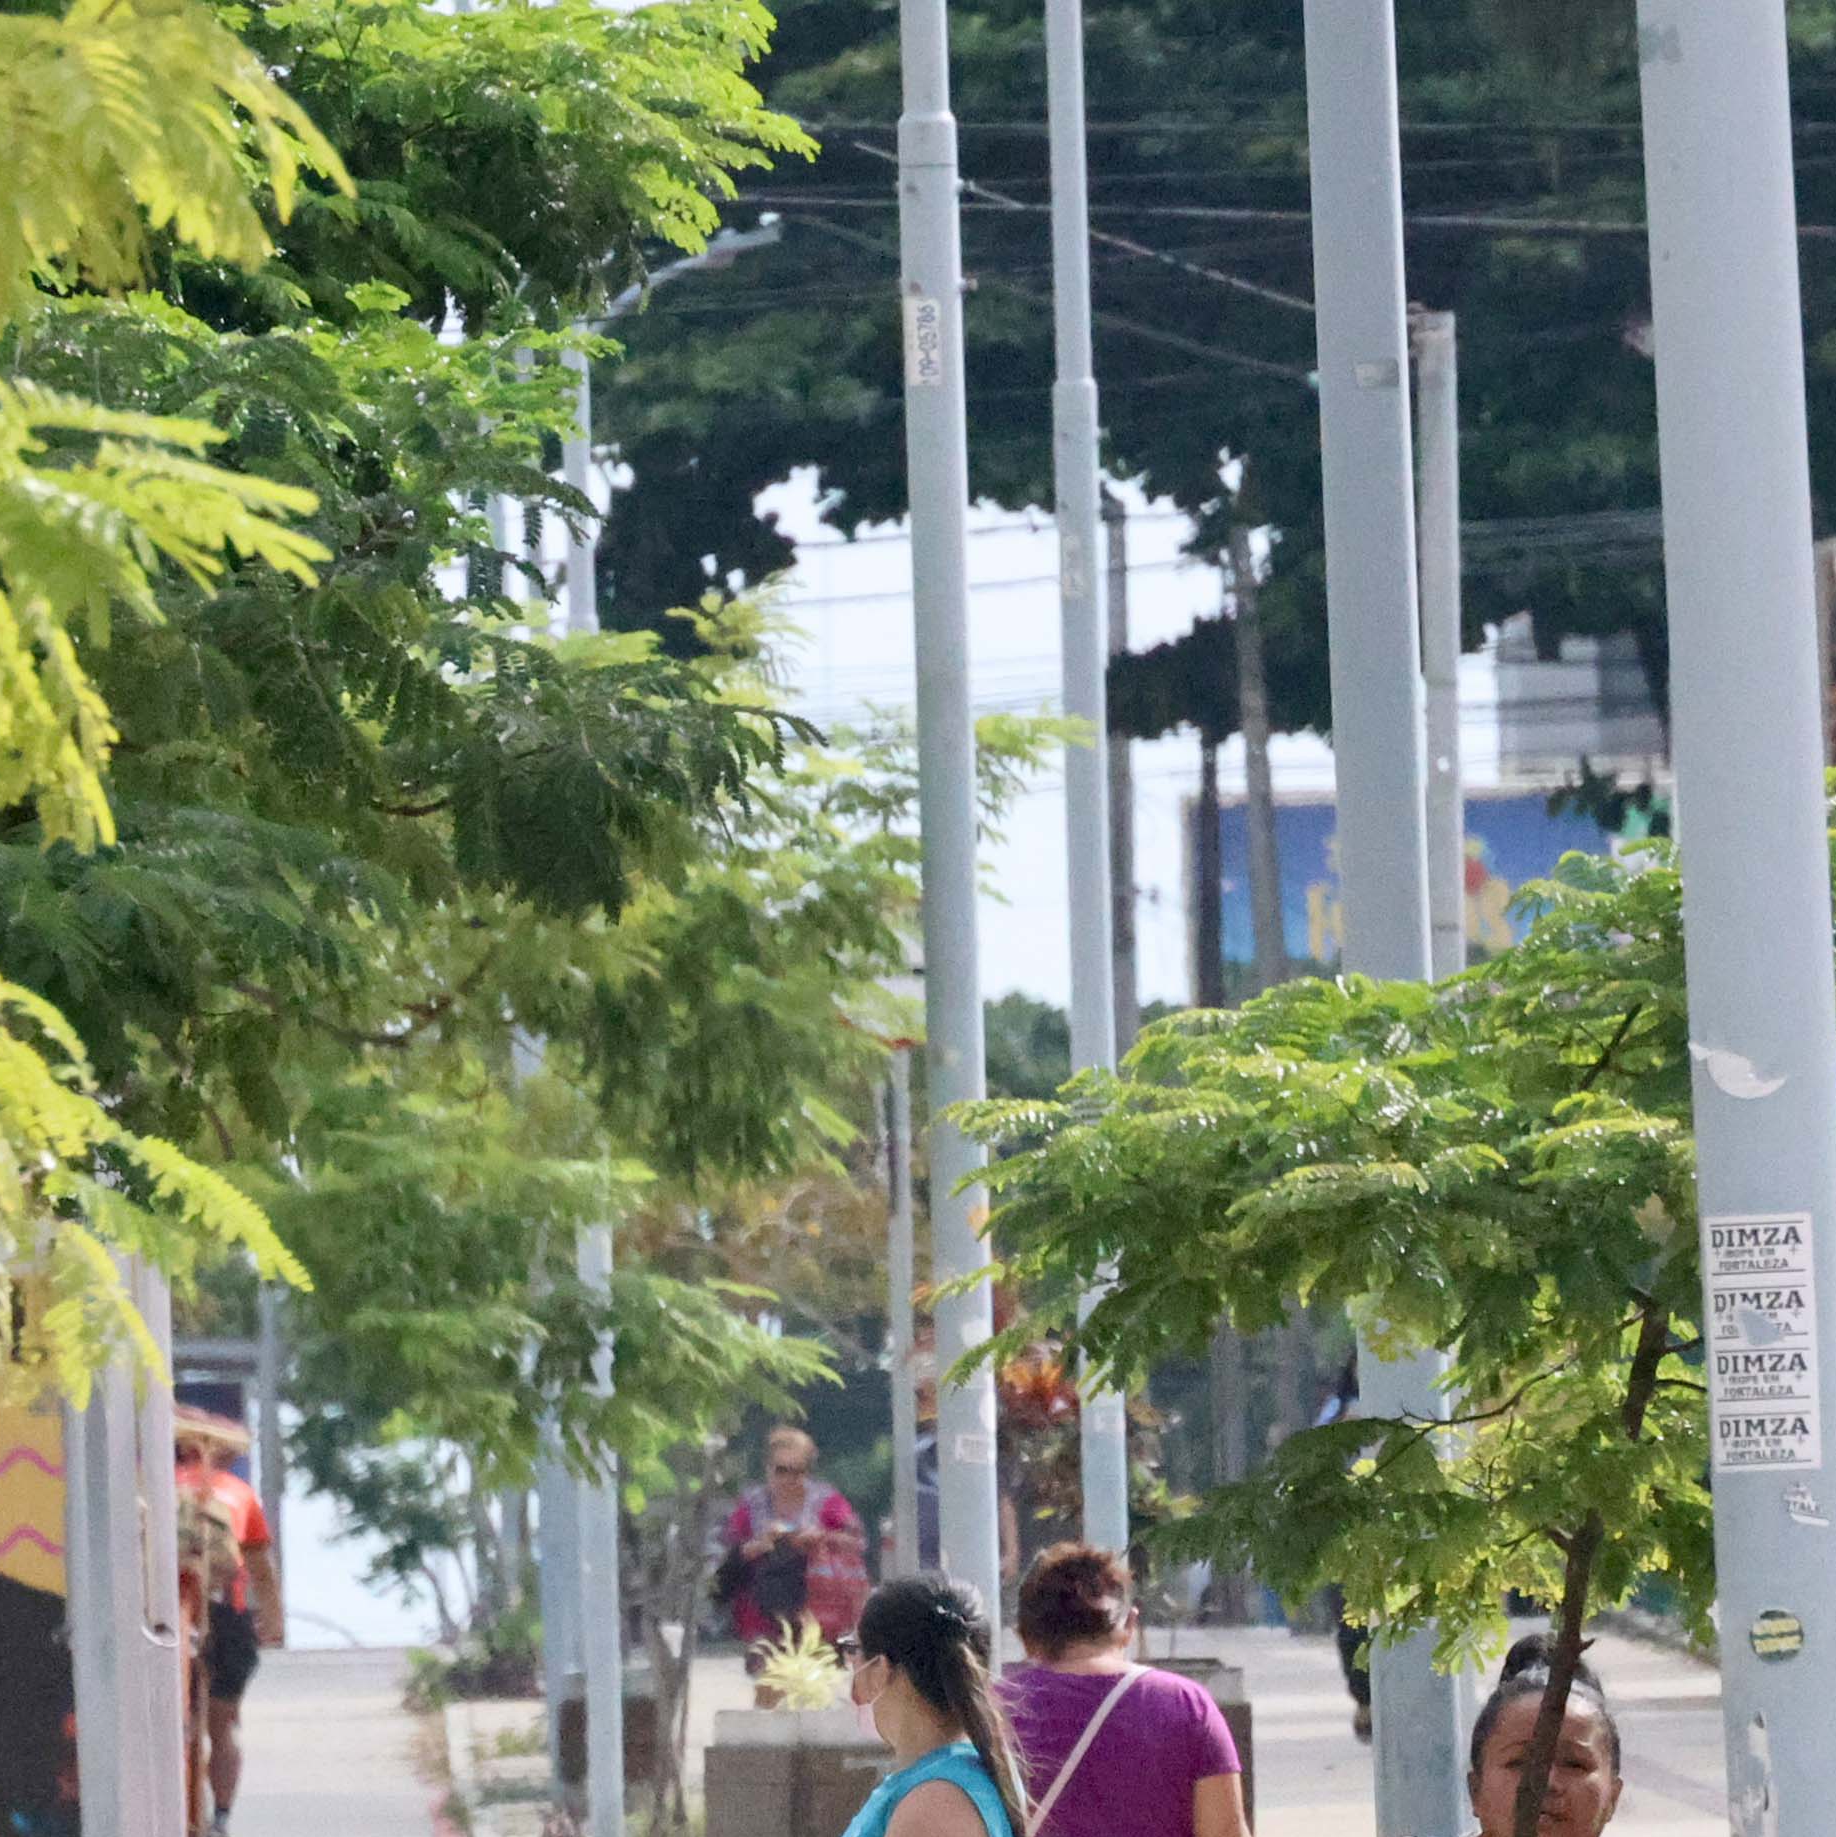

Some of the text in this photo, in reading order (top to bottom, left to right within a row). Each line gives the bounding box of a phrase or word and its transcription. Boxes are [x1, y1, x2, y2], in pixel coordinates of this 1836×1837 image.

[1711, 1226, 1803, 1249] DIMZA
[1719, 1258, 1790, 1271] FORTALEZA
[1714, 1290, 1806, 1313] DIMZA
[1717, 1353, 1808, 1375] DIMZA
[1723, 1385, 1794, 1398] FORTALEZA
[1719, 1417, 1810, 1439] DIMZA
[1725, 1449, 1796, 1461] FORTALEZA
